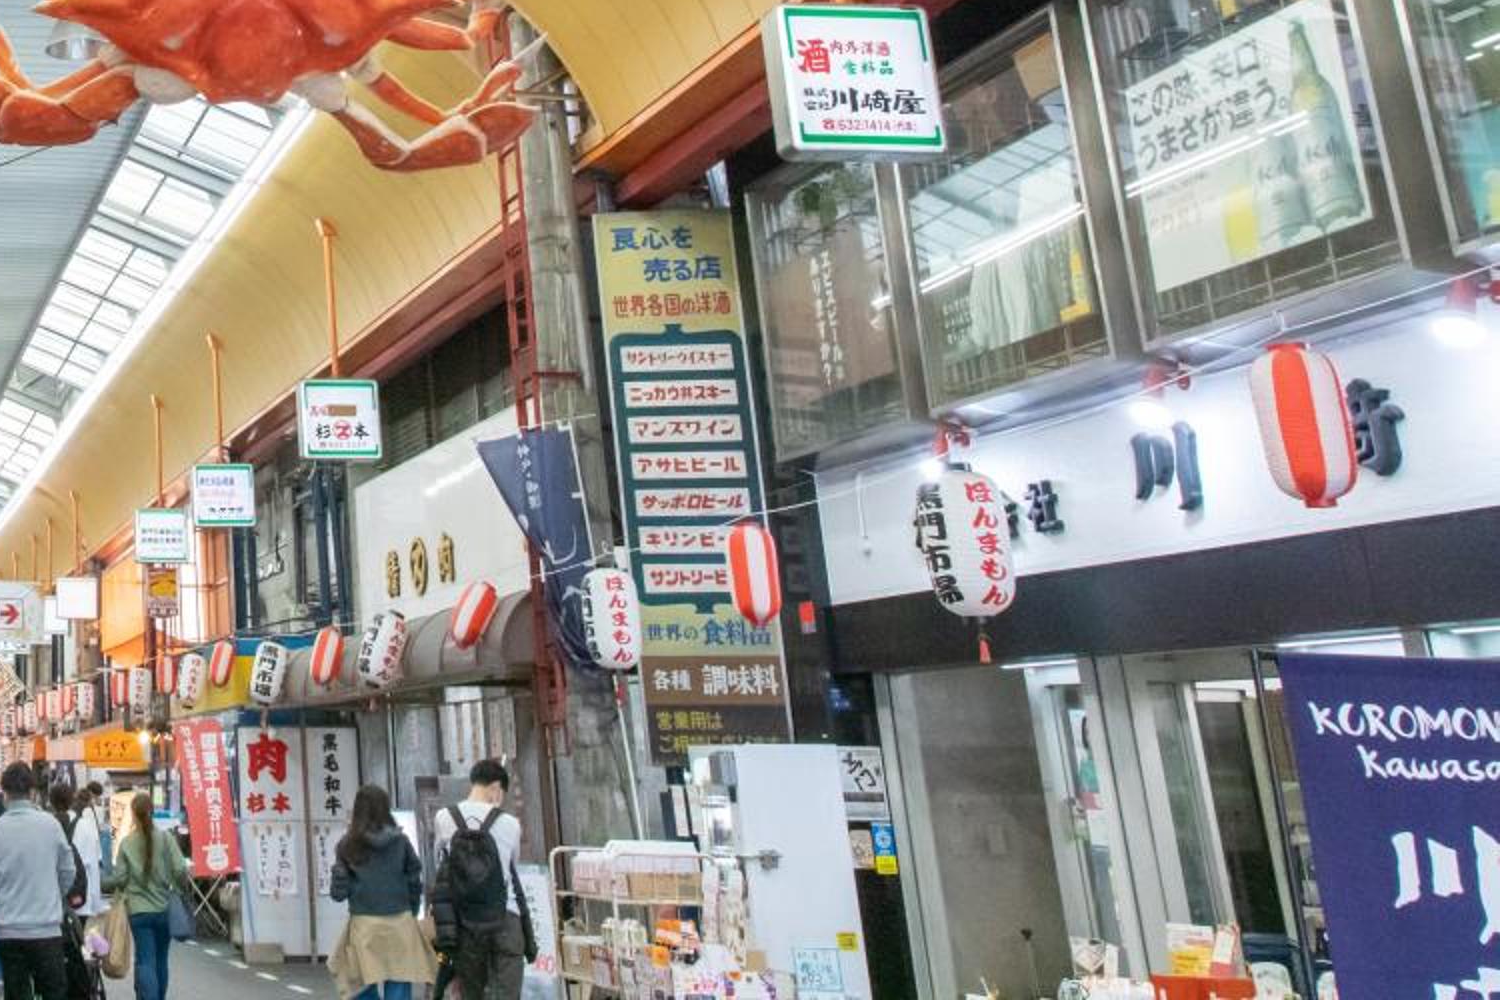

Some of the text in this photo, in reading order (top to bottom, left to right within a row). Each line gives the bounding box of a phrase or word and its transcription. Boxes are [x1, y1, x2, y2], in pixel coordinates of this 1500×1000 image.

[797, 39, 891, 74] 酒 内外洋酒
[611, 226, 693, 252] 良心を
[643, 255, 722, 283] 売る店
[611, 293, 732, 318] 世界各国の洋酒
[637, 456, 740, 474] アサヒビール
[641, 493, 744, 512] サッポロビール
[644, 530, 726, 549] キリンビー
[915, 484, 965, 606] 黒門市場
[964, 479, 1009, 606] ほんまもん
[649, 568, 727, 587] サントリービ
[605, 576, 633, 664] ほんまもん
[645, 622, 698, 643] 世界の
[254, 645, 276, 699] 黒門市場
[652, 663, 780, 697] 各種 調味料
[246, 733, 289, 784] 肉
[323, 733, 343, 817] 黒毛和牛
[247, 791, 291, 814] 杉本
